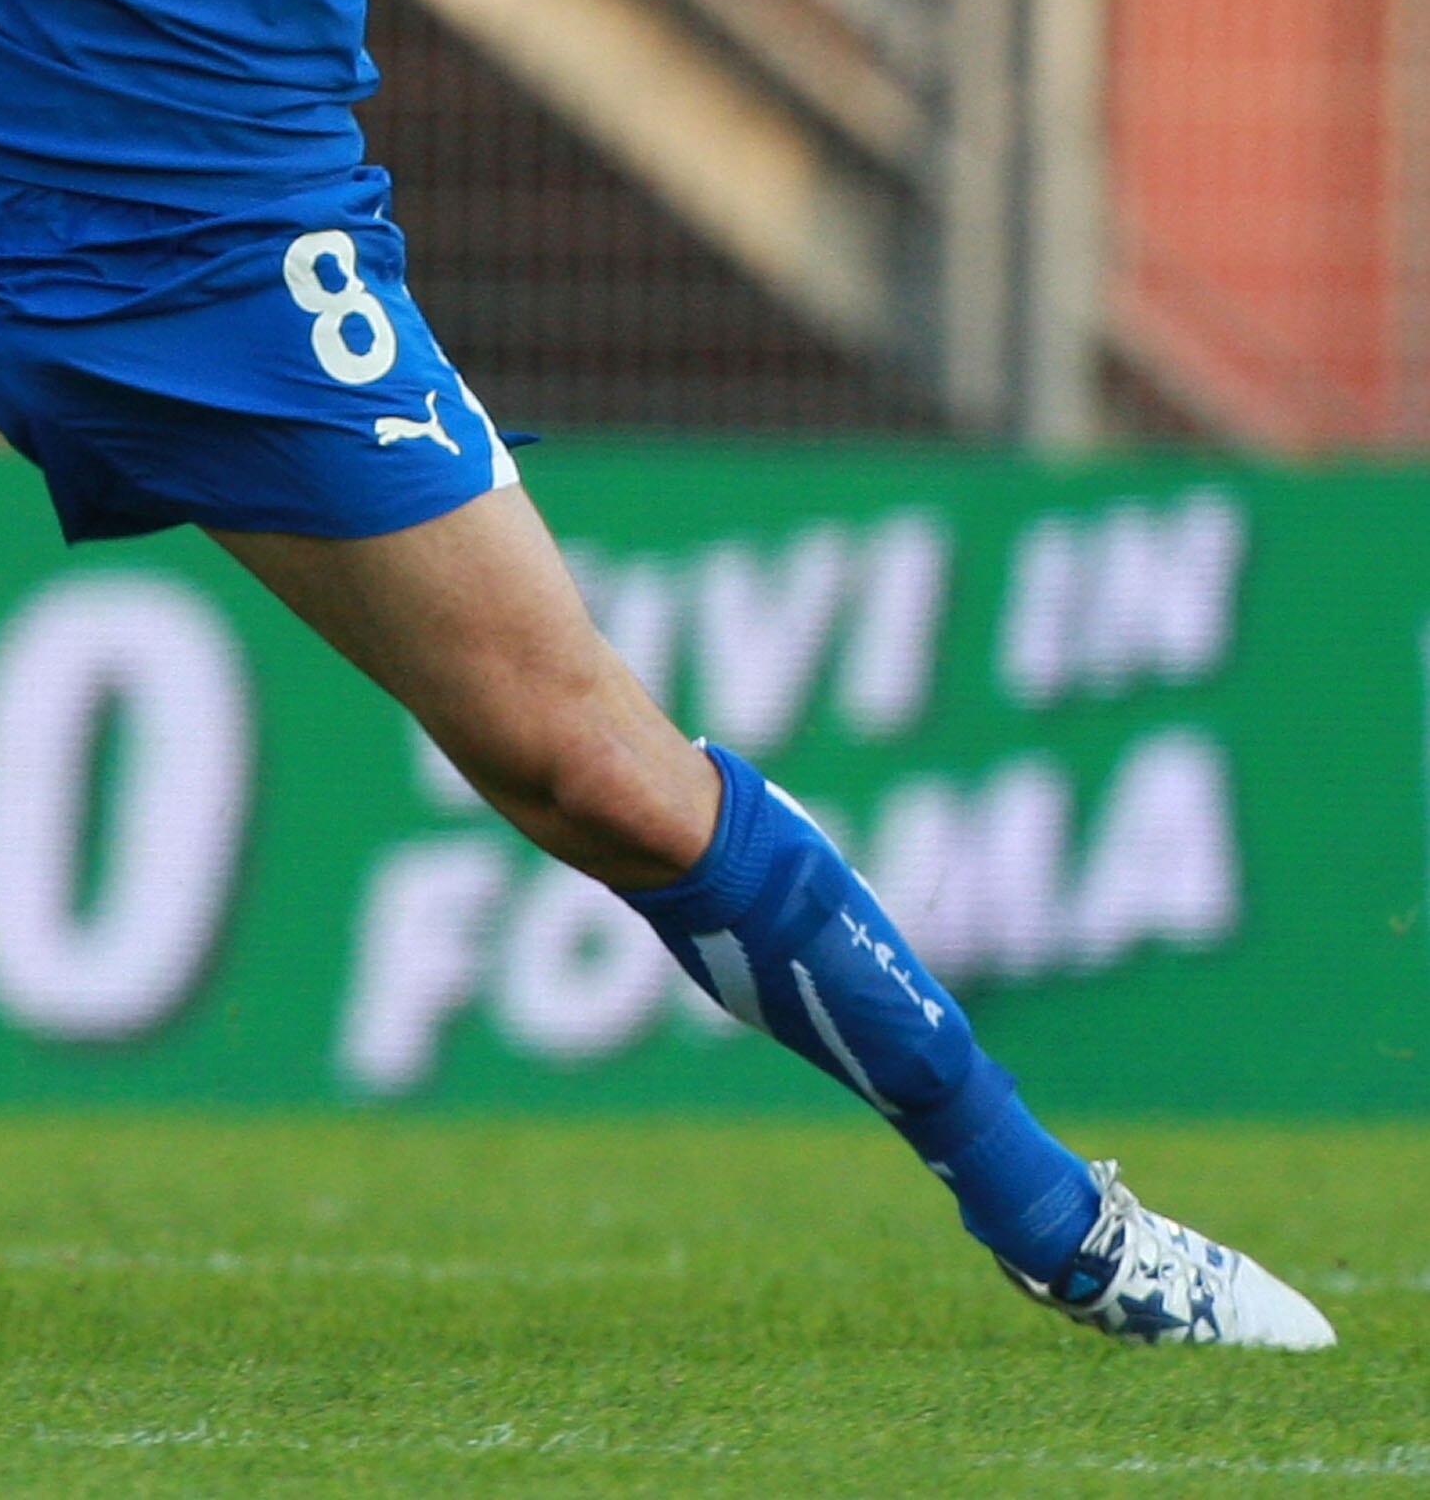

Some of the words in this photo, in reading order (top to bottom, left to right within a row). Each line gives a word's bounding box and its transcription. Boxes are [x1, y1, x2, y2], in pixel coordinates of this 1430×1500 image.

[283, 229, 397, 385] 8
[1000, 485, 1244, 703] IN
[338, 722, 1242, 1102] FOMA
[839, 905, 945, 1029] ITALIA
